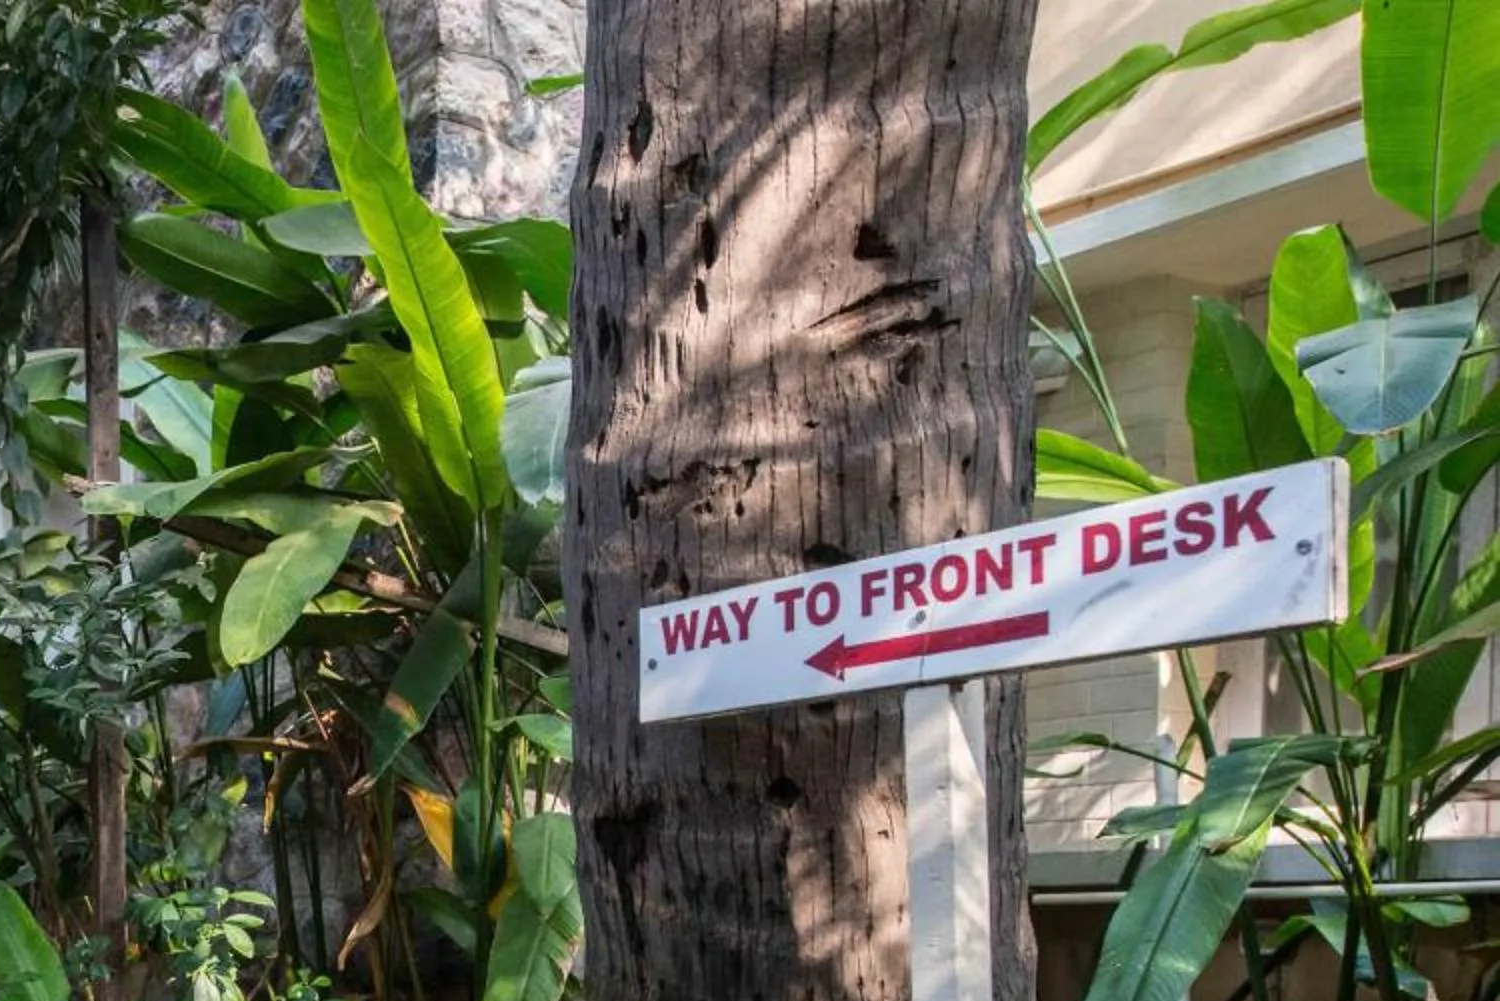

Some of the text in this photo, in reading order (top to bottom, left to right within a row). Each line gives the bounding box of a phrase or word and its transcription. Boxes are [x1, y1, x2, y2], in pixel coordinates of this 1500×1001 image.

[661, 487, 1276, 655] WAY TO FRONT DESK
